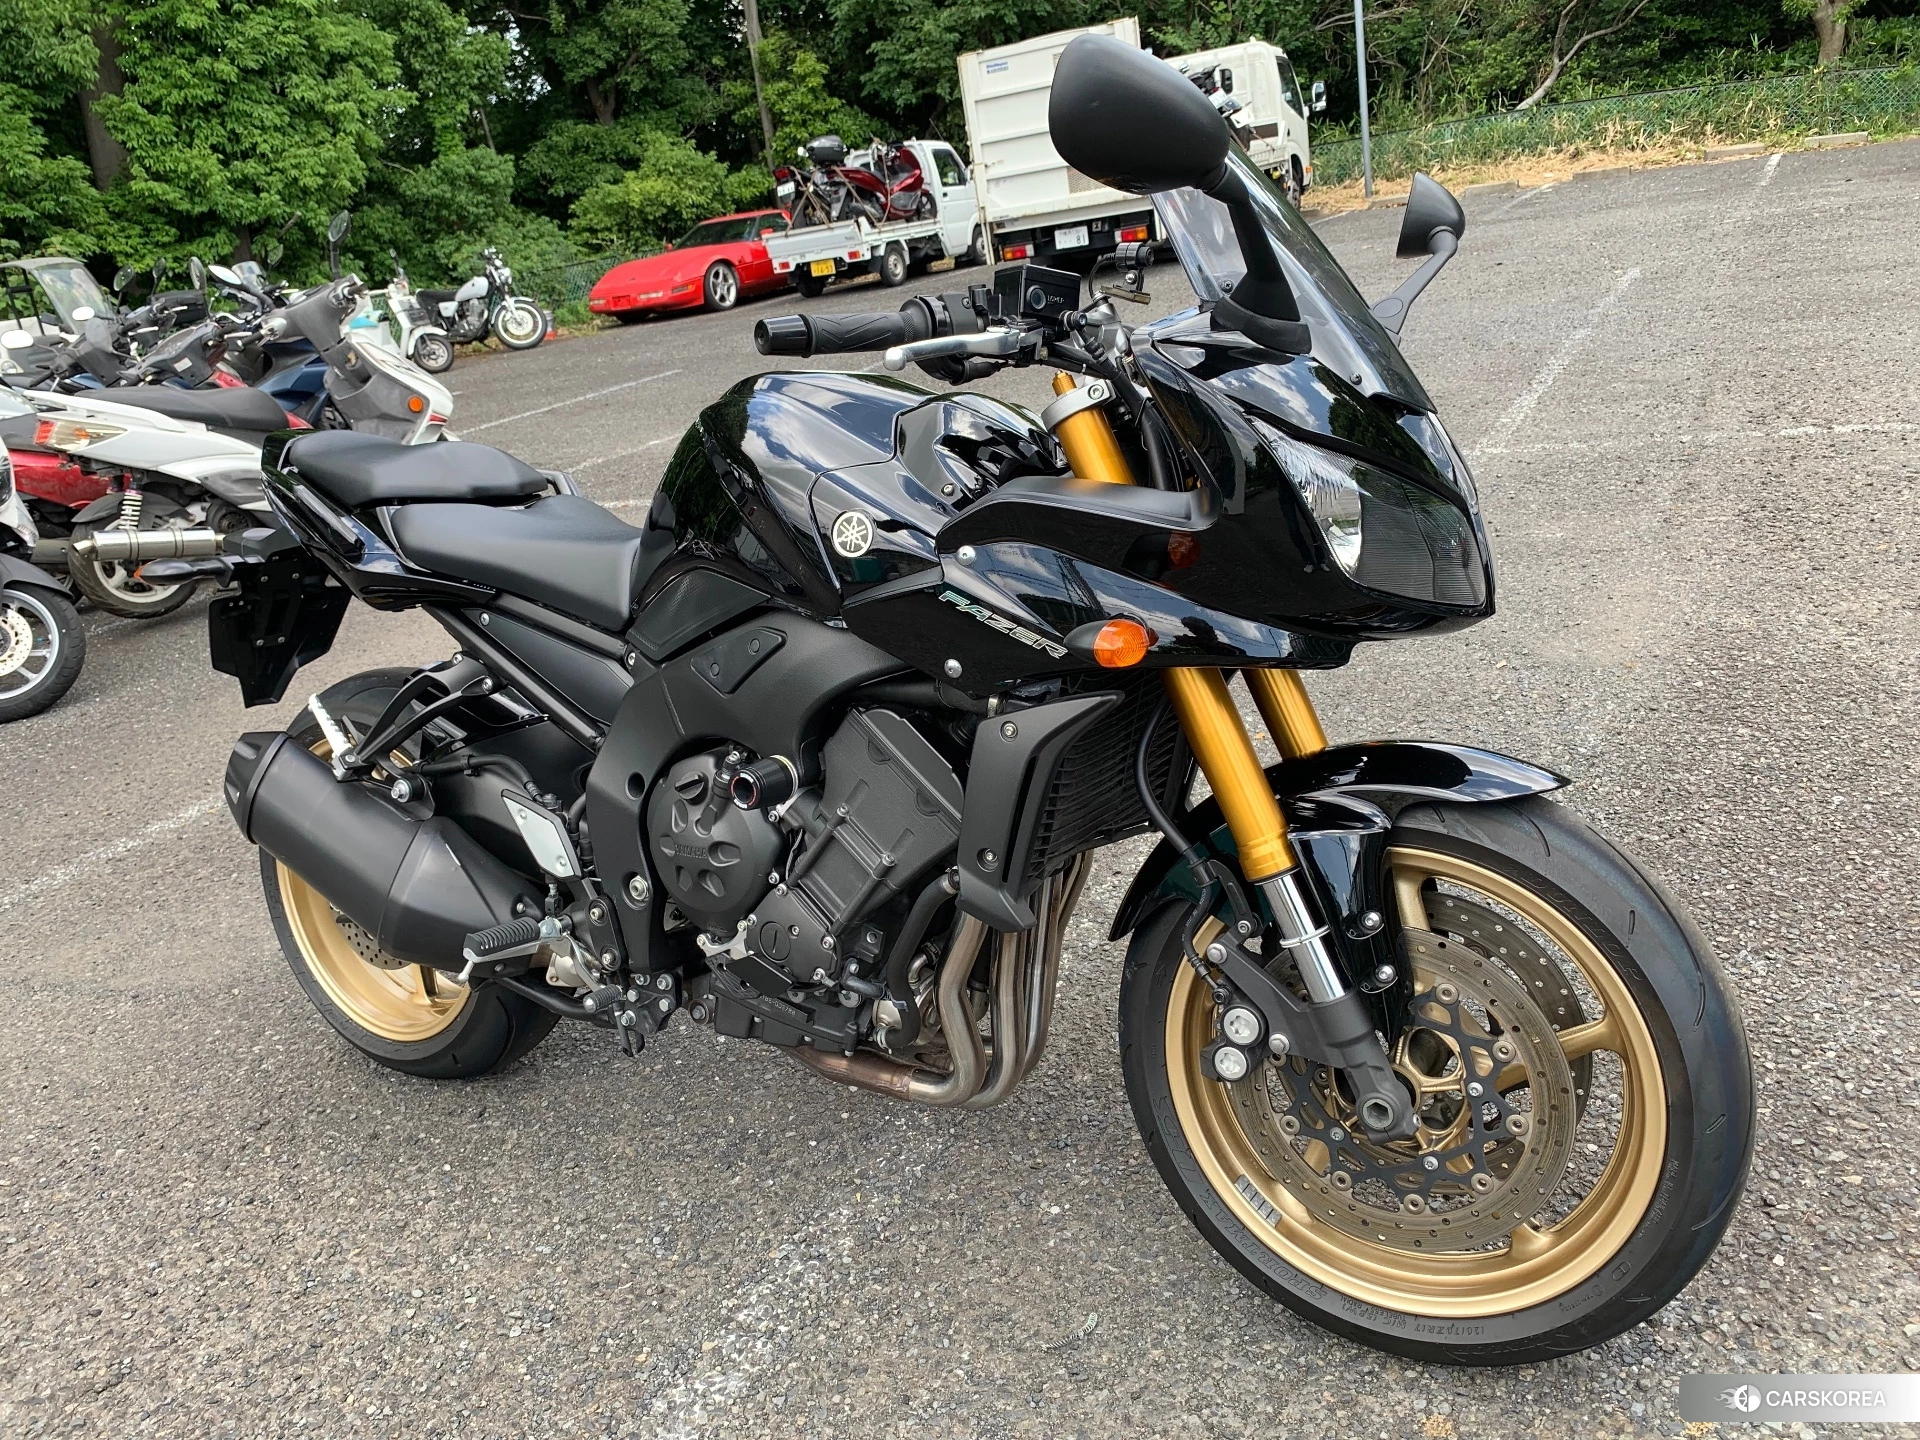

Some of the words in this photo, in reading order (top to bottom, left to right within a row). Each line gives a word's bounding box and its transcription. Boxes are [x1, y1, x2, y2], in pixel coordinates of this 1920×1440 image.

[938, 590, 1069, 659] FAZER
[675, 844, 709, 859] YAMAHA
[1198, 1191, 1328, 1300] SPORTMAX
